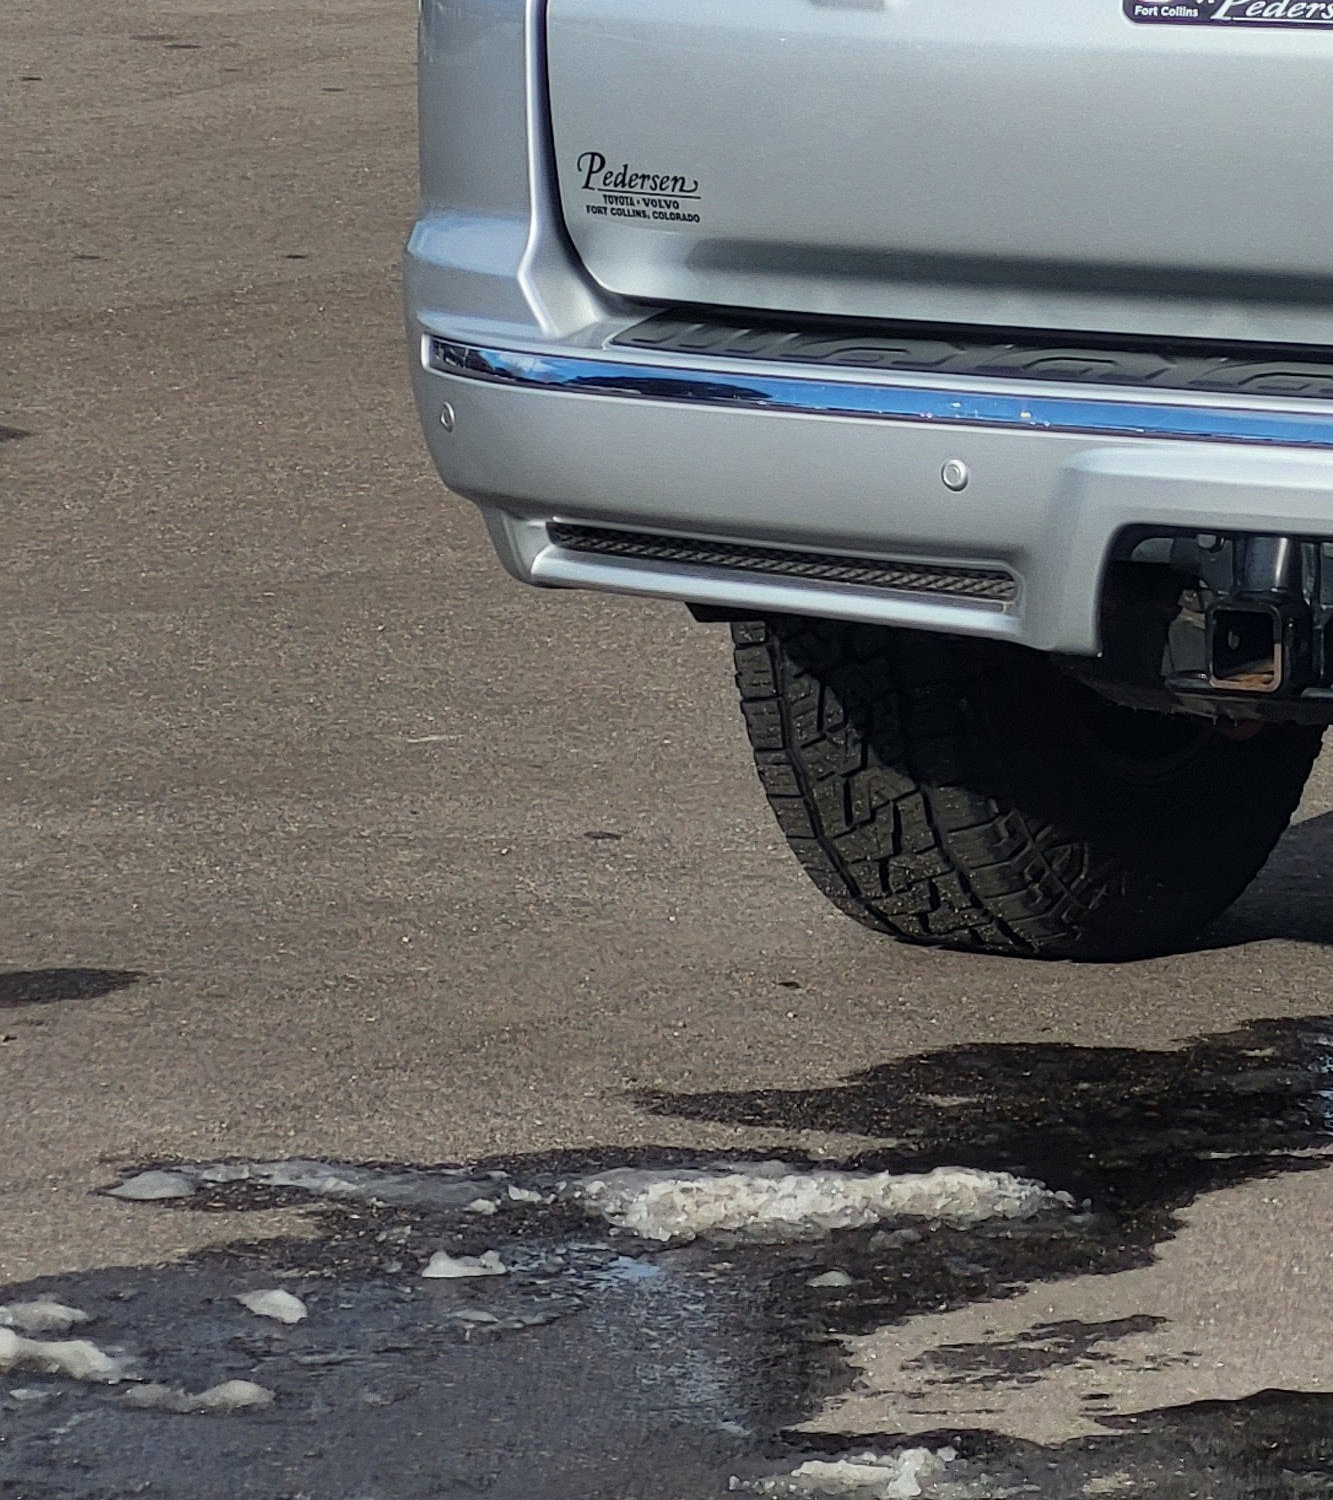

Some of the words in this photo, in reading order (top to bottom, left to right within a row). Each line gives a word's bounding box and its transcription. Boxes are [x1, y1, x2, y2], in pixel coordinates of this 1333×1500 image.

[1134, 5, 1158, 17] Fort
[1160, 5, 1199, 18] Collins
[577, 151, 699, 193] Pedersen
